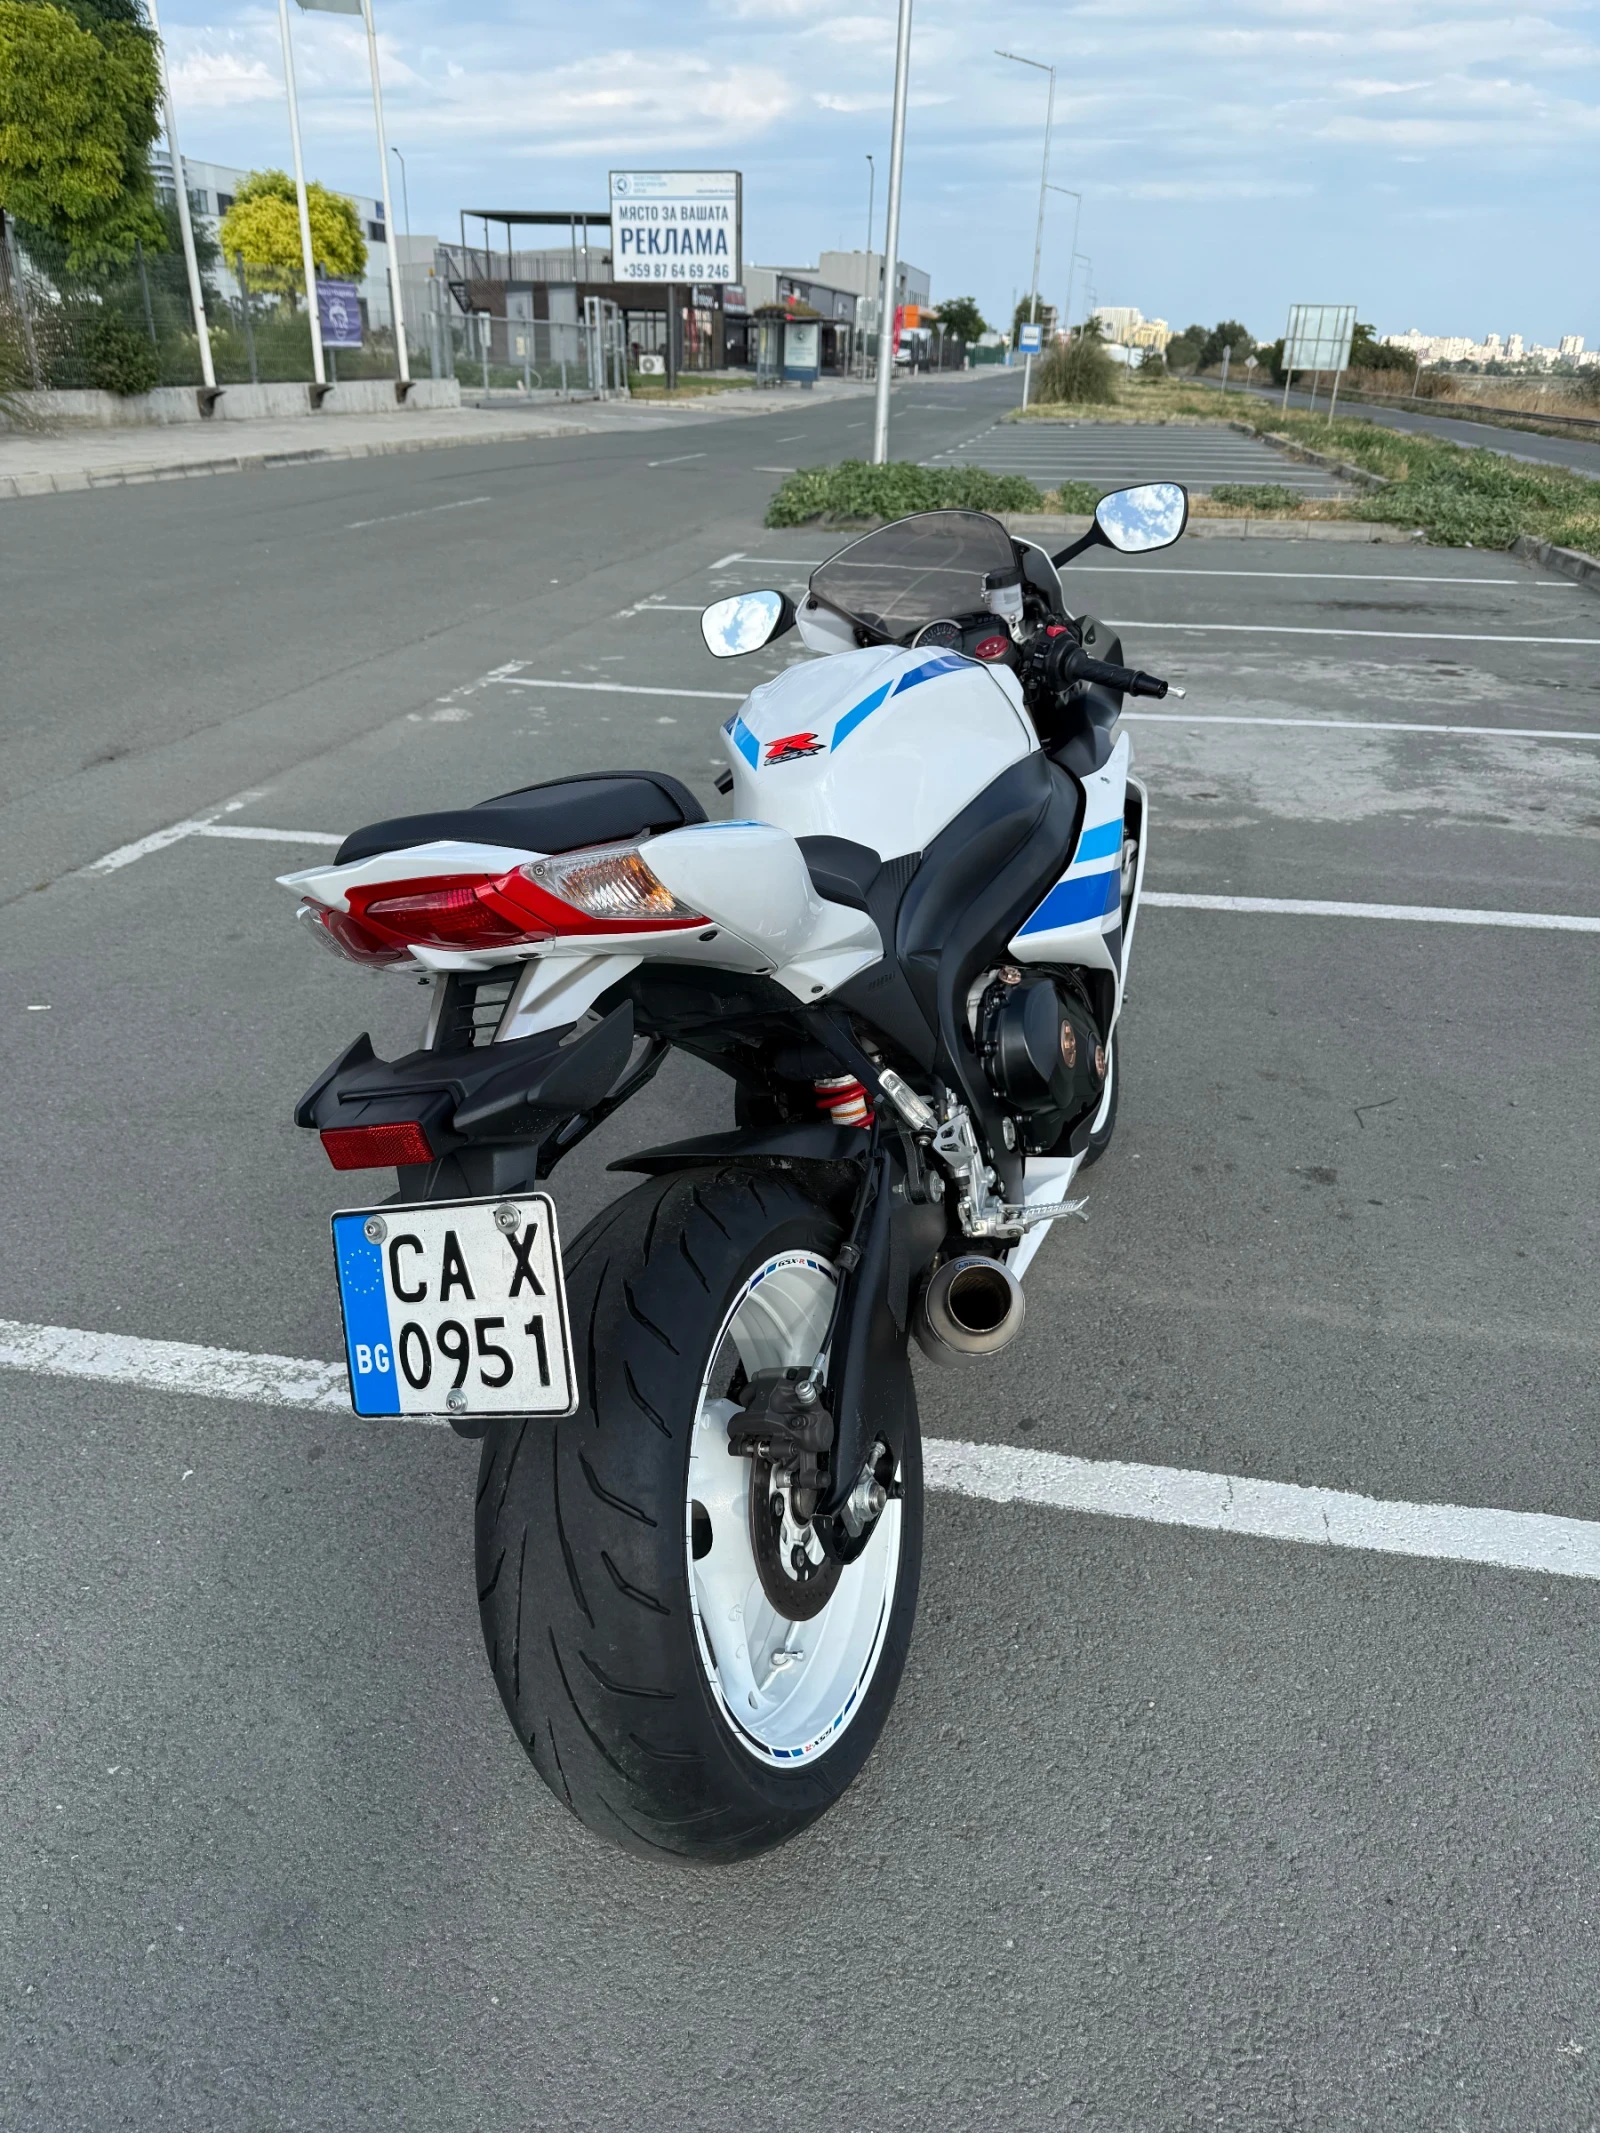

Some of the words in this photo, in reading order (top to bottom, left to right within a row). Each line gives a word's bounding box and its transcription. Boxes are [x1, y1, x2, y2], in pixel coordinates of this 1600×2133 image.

[619, 206, 658, 221] МЯСТО
[662, 206, 677, 221] ЗА
[681, 206, 729, 221] ВАШАТА
[620, 227, 728, 255] РЕКЛАМА
[623, 264, 650, 278] +359
[654, 264, 667, 278] 87
[671, 264, 685, 278] 64
[689, 264, 703, 278] 69
[707, 264, 729, 279] 246
[388, 1230, 476, 1303] CA
[355, 1343, 391, 1374] BG
[398, 1314, 551, 1390] 0951
